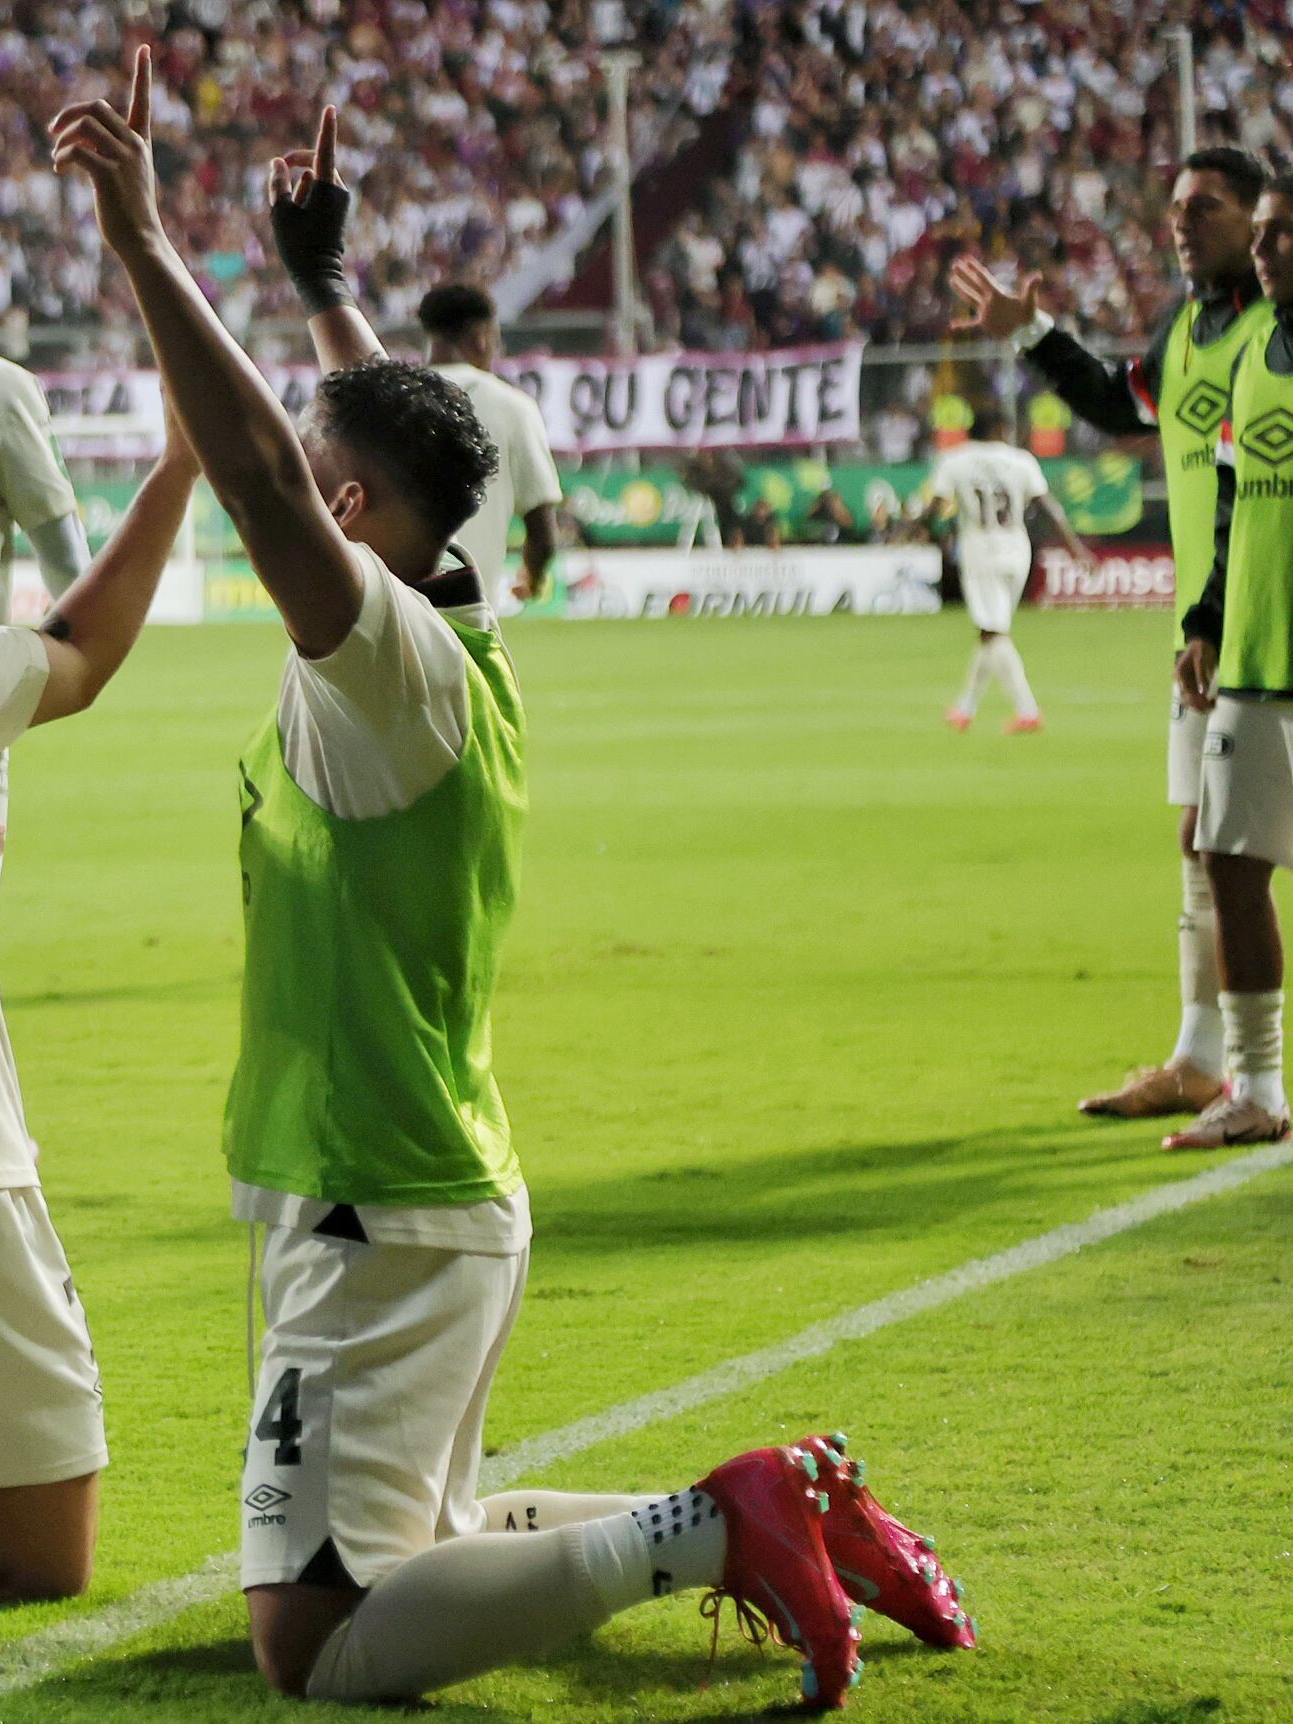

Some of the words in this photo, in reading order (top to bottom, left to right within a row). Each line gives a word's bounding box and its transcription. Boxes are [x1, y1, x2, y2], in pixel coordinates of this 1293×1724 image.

[664, 358, 845, 434] GENTE
[1181, 443, 1218, 472] umb
[255, 1367, 304, 1467] 4
